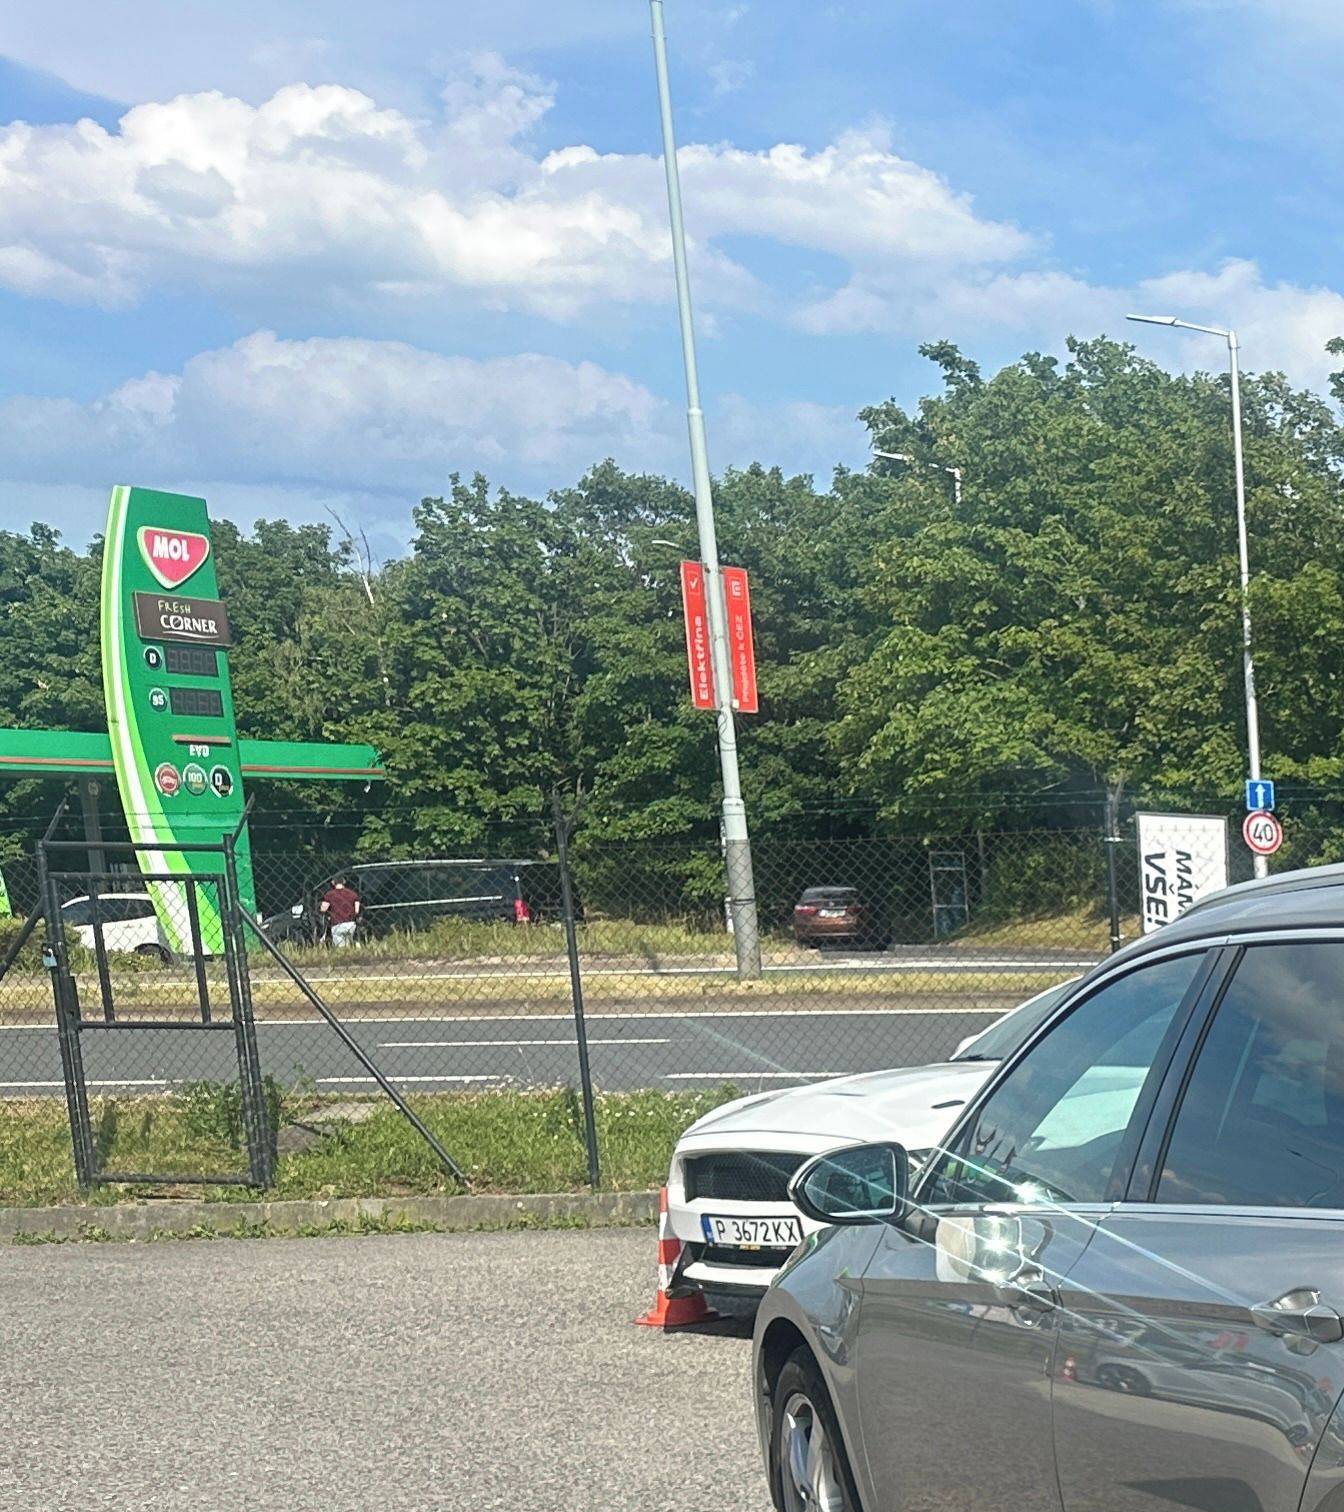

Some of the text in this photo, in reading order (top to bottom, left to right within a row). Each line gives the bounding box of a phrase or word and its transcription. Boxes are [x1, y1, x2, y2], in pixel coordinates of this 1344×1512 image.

[152, 535, 190, 562] MOL
[157, 600, 191, 614] FRESH
[160, 614, 218, 634] CORNER
[152, 695, 164, 706] 95
[189, 744, 210, 758] EVO
[1253, 823, 1274, 842] 40
[715, 1220, 798, 1242] P 3672KX
